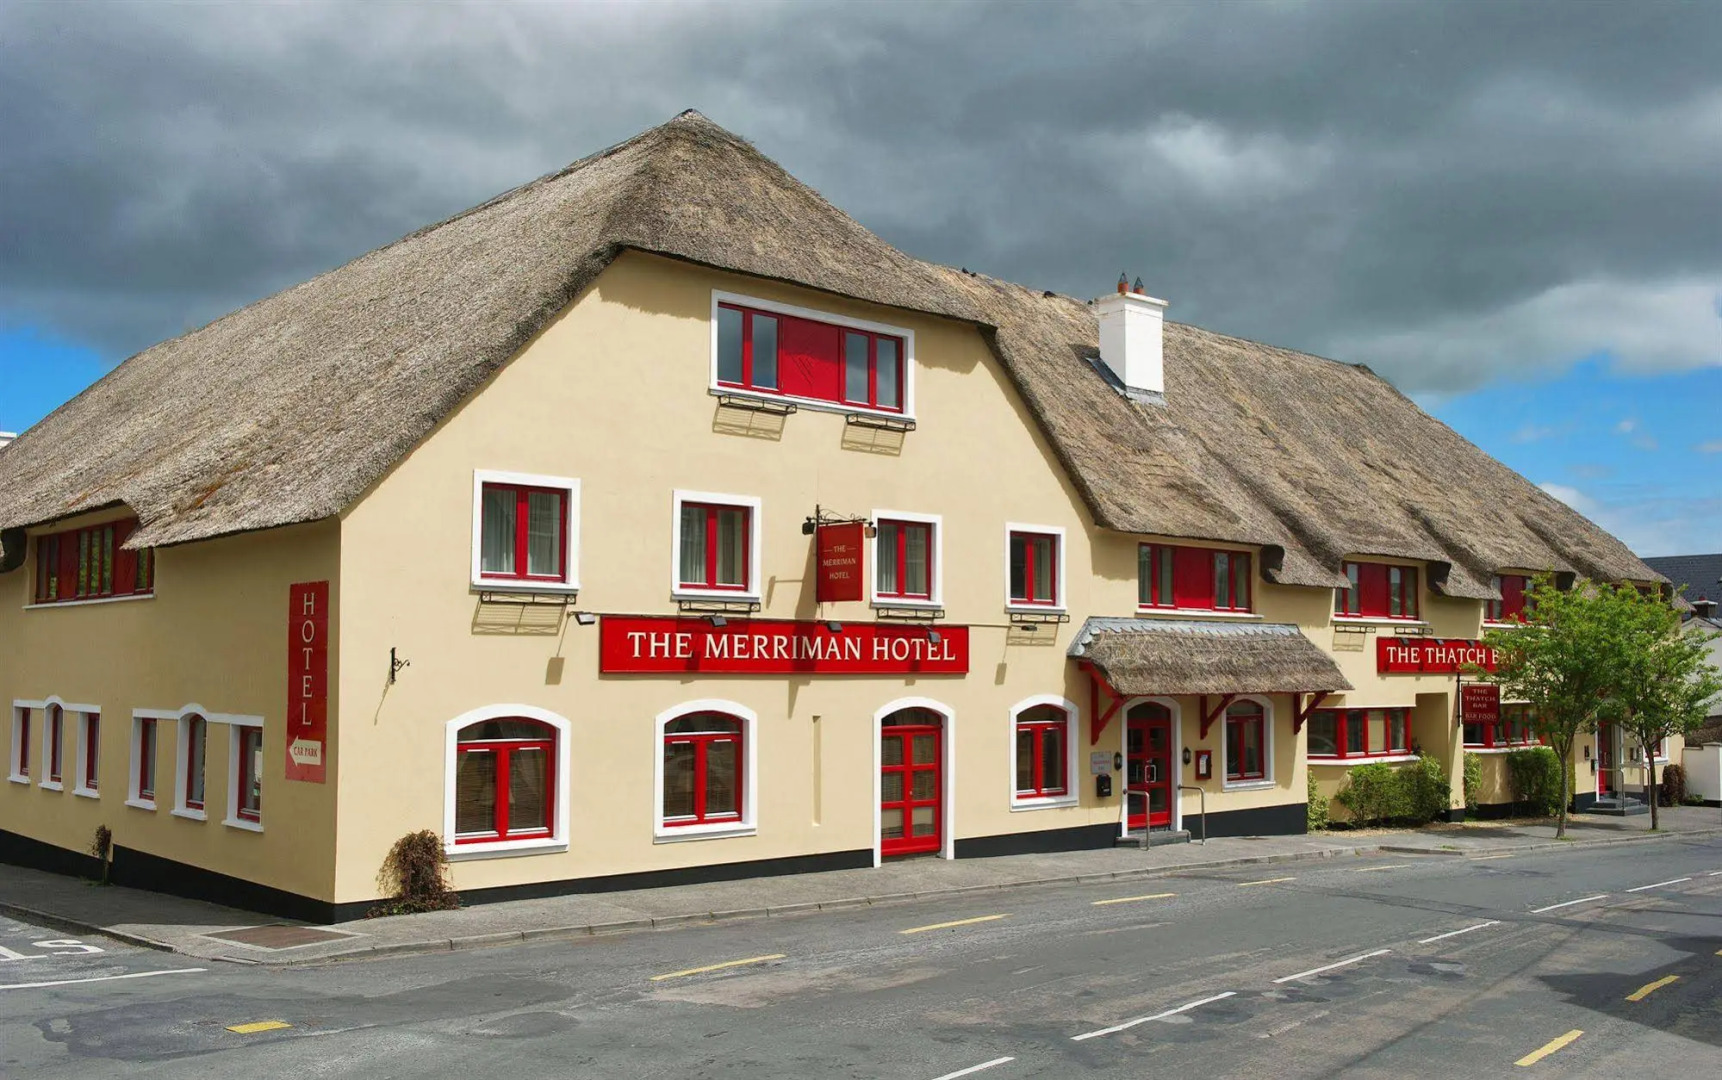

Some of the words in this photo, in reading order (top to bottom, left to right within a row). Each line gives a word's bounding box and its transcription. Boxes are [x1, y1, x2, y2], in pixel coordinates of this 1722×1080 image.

[833, 545, 846, 553] THE
[823, 558, 856, 567] MERRIMAN
[829, 572, 850, 580] HOTEL
[627, 631, 693, 658] THE
[704, 634, 861, 661] MERRIMAN
[871, 636, 956, 661] HOTEL
[302, 592, 315, 726] HOTEL
[1386, 646, 1420, 664] THE
[1425, 647, 1486, 664] THATCH
[293, 746, 303, 756] CAR
[304, 747, 318, 757] PARK
